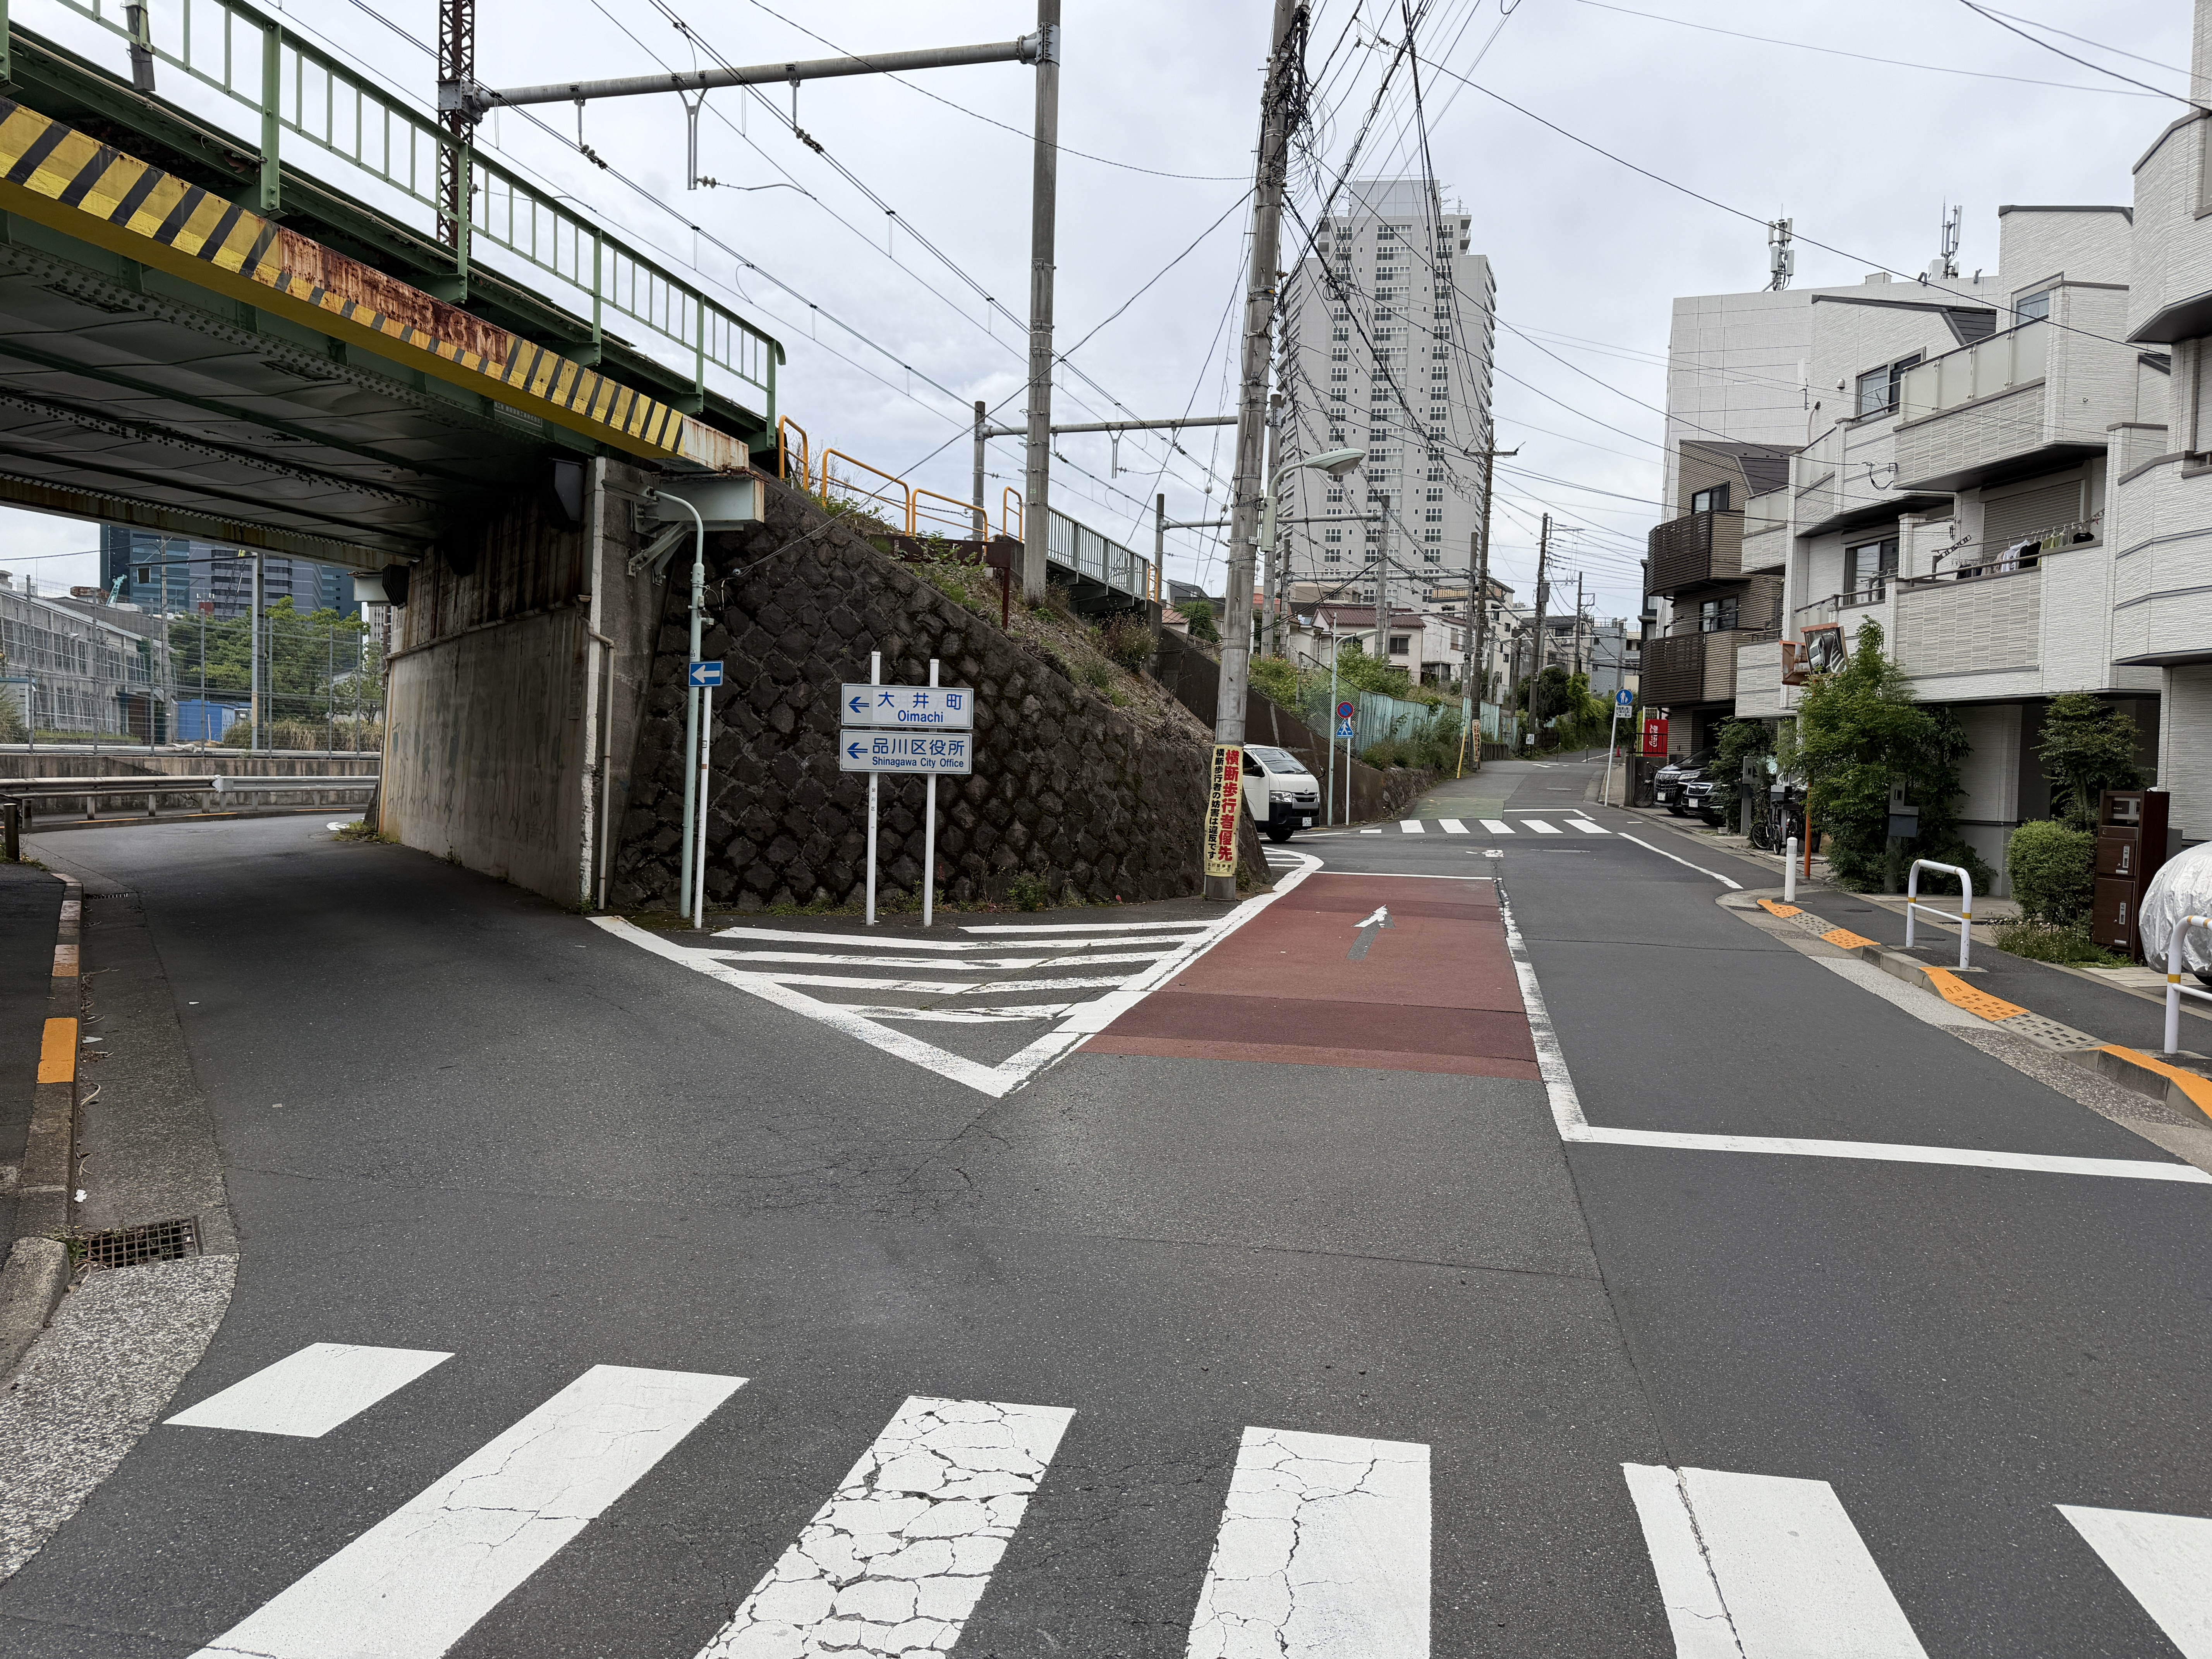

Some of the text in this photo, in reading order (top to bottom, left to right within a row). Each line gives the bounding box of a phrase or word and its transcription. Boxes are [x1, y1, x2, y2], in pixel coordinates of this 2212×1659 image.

[878, 691, 962, 710] 大井町
[898, 710, 943, 723] Oimachi
[872, 738, 965, 756] 品川区役所
[872, 756, 964, 768] Shinagawa City Office
[1207, 749, 1224, 859] 横断歩行者の妨害は違反です
[1218, 749, 1239, 861] 横断歩行者優先
